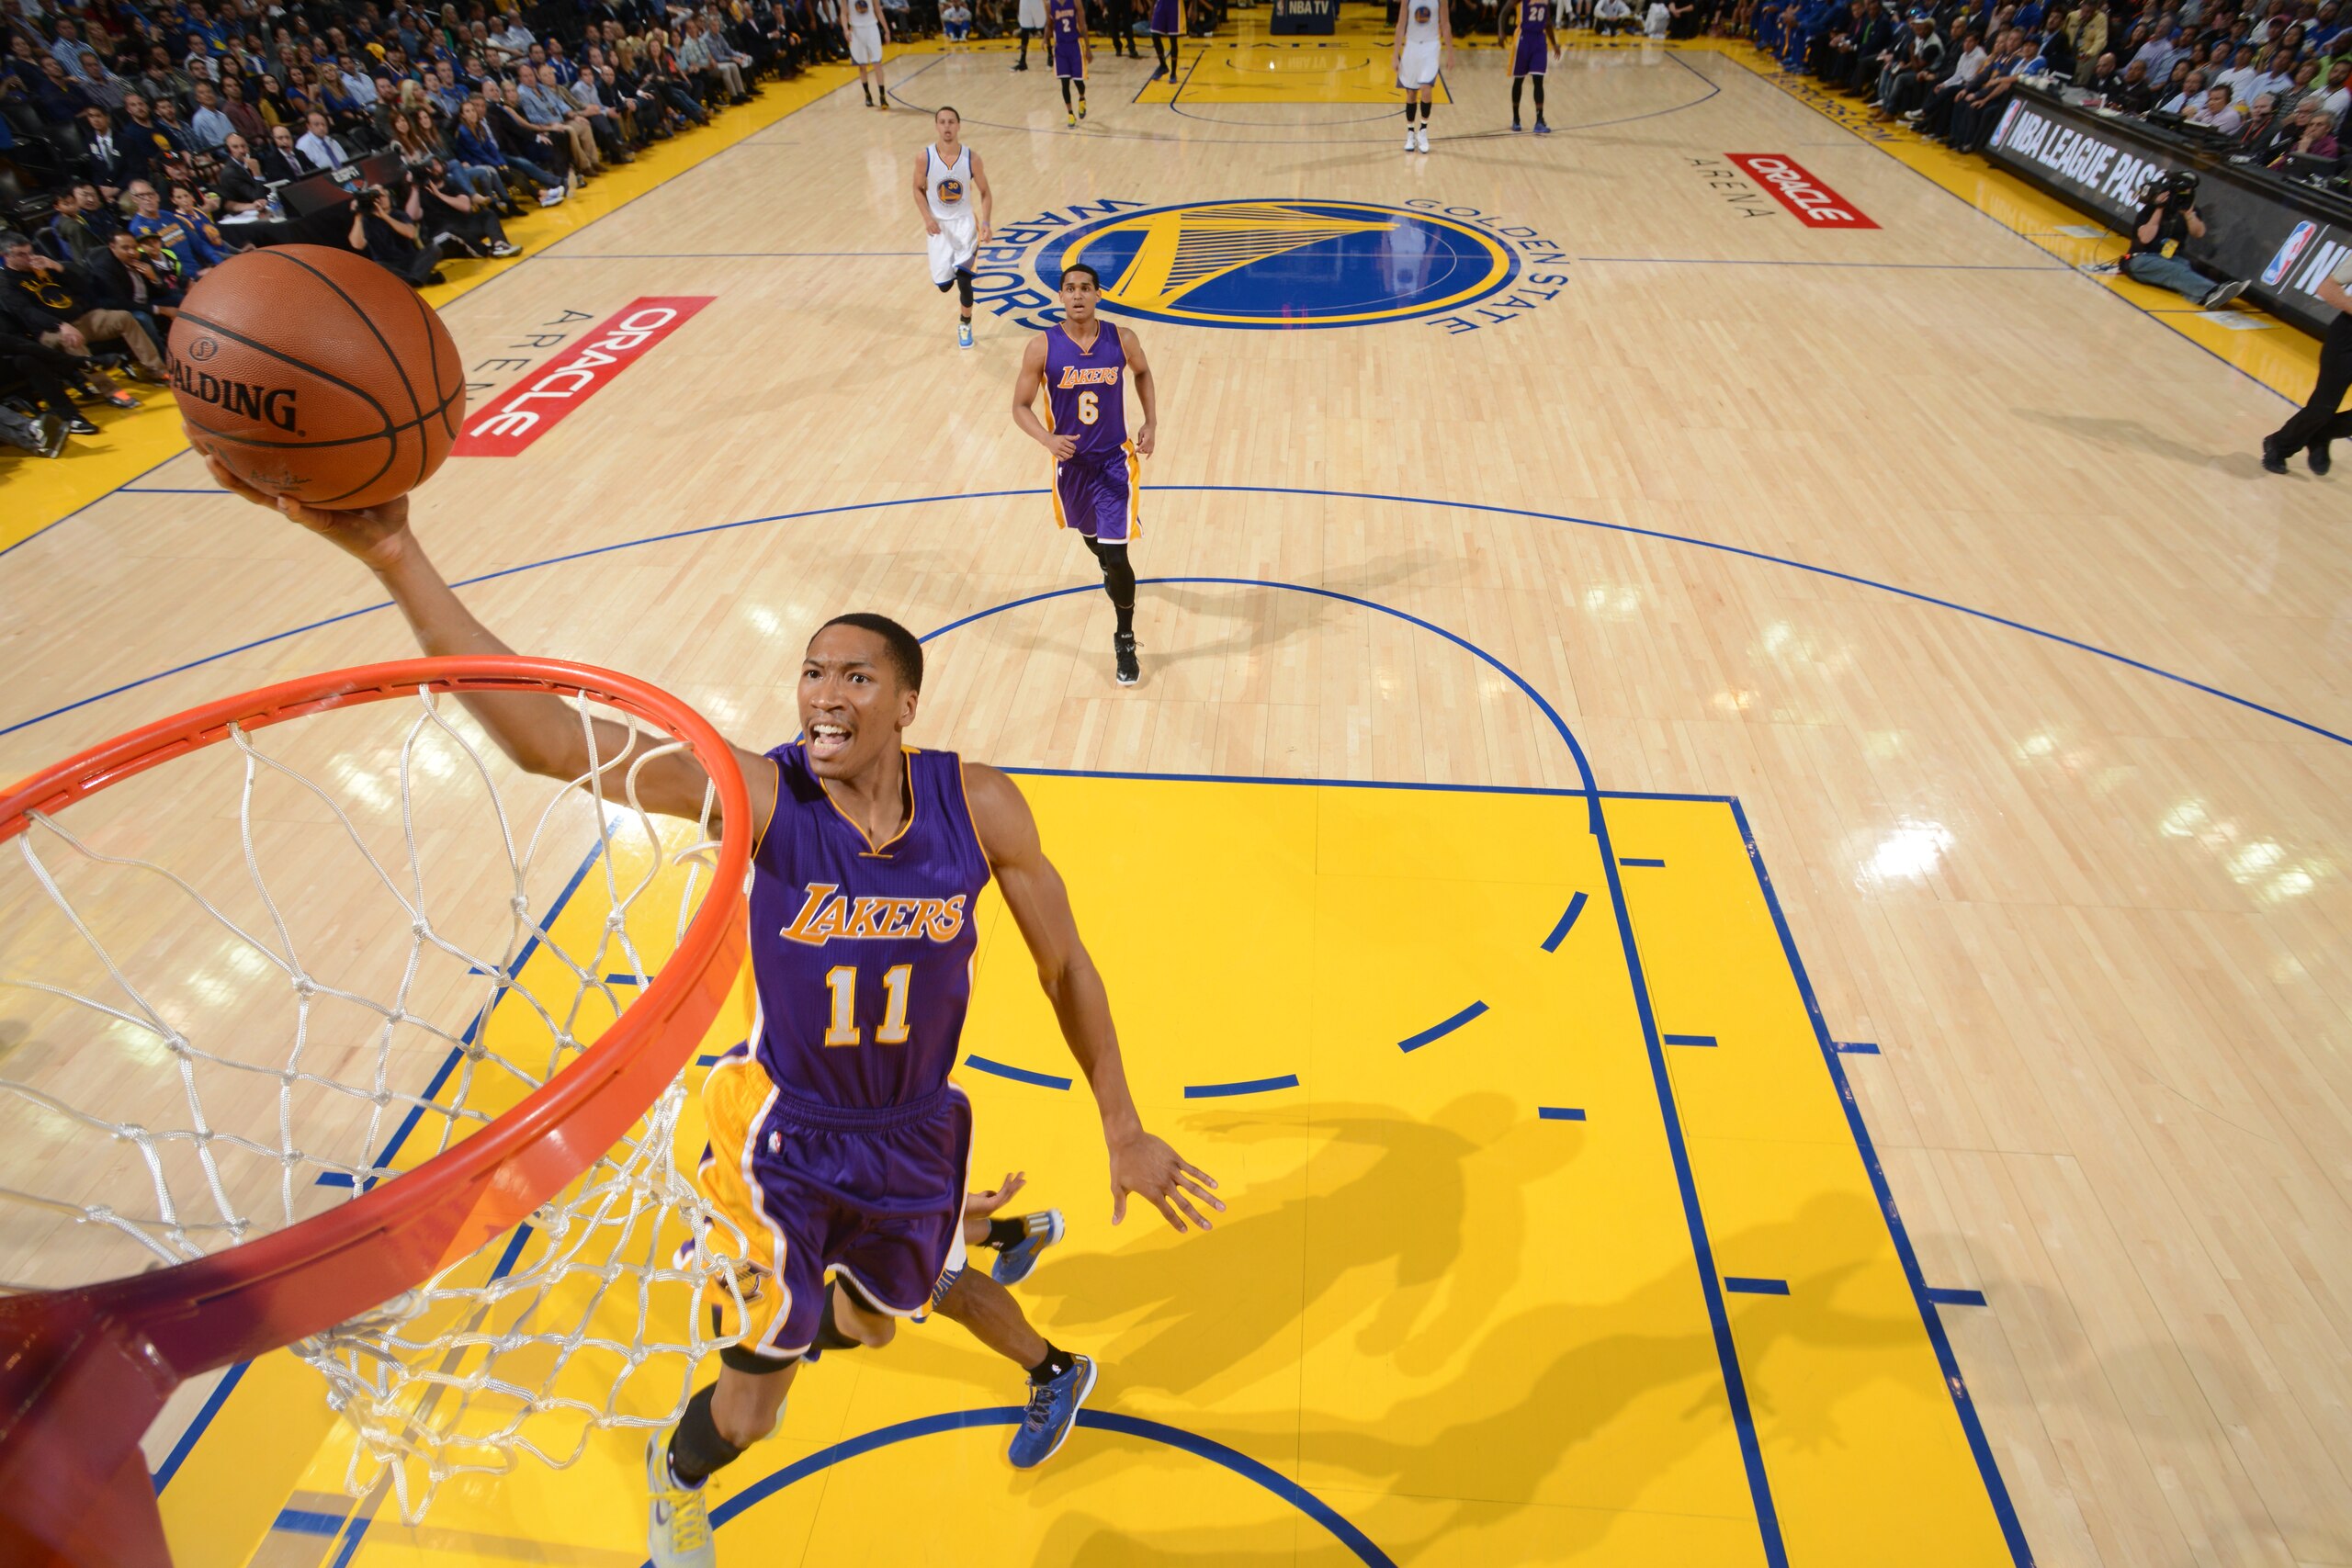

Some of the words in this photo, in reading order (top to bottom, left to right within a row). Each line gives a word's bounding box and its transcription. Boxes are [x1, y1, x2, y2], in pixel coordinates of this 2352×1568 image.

[1061, 18, 1071, 33] 2
[1288, 0, 1312, 15] NBA
[1314, 0, 1329, 15] TV
[2007, 110, 2052, 159] NBA
[2036, 125, 2118, 189] LEAGUE
[948, 182, 958, 190] 30
[1683, 157, 1776, 218] ARENA
[1747, 158, 1855, 221] ORACLE
[1405, 198, 1570, 265] GOLDEN
[971, 198, 1150, 331] WARRIORS
[1425, 273, 1568, 334] STATE
[465, 310, 594, 400] AREN
[469, 308, 677, 437] ORACLE
[1057, 366, 1118, 389] LAKERS
[168, 350, 297, 433] ALDING
[1078, 390, 1099, 425] 6
[779, 882, 967, 947] LAKERS
[825, 964, 912, 1047] 11
